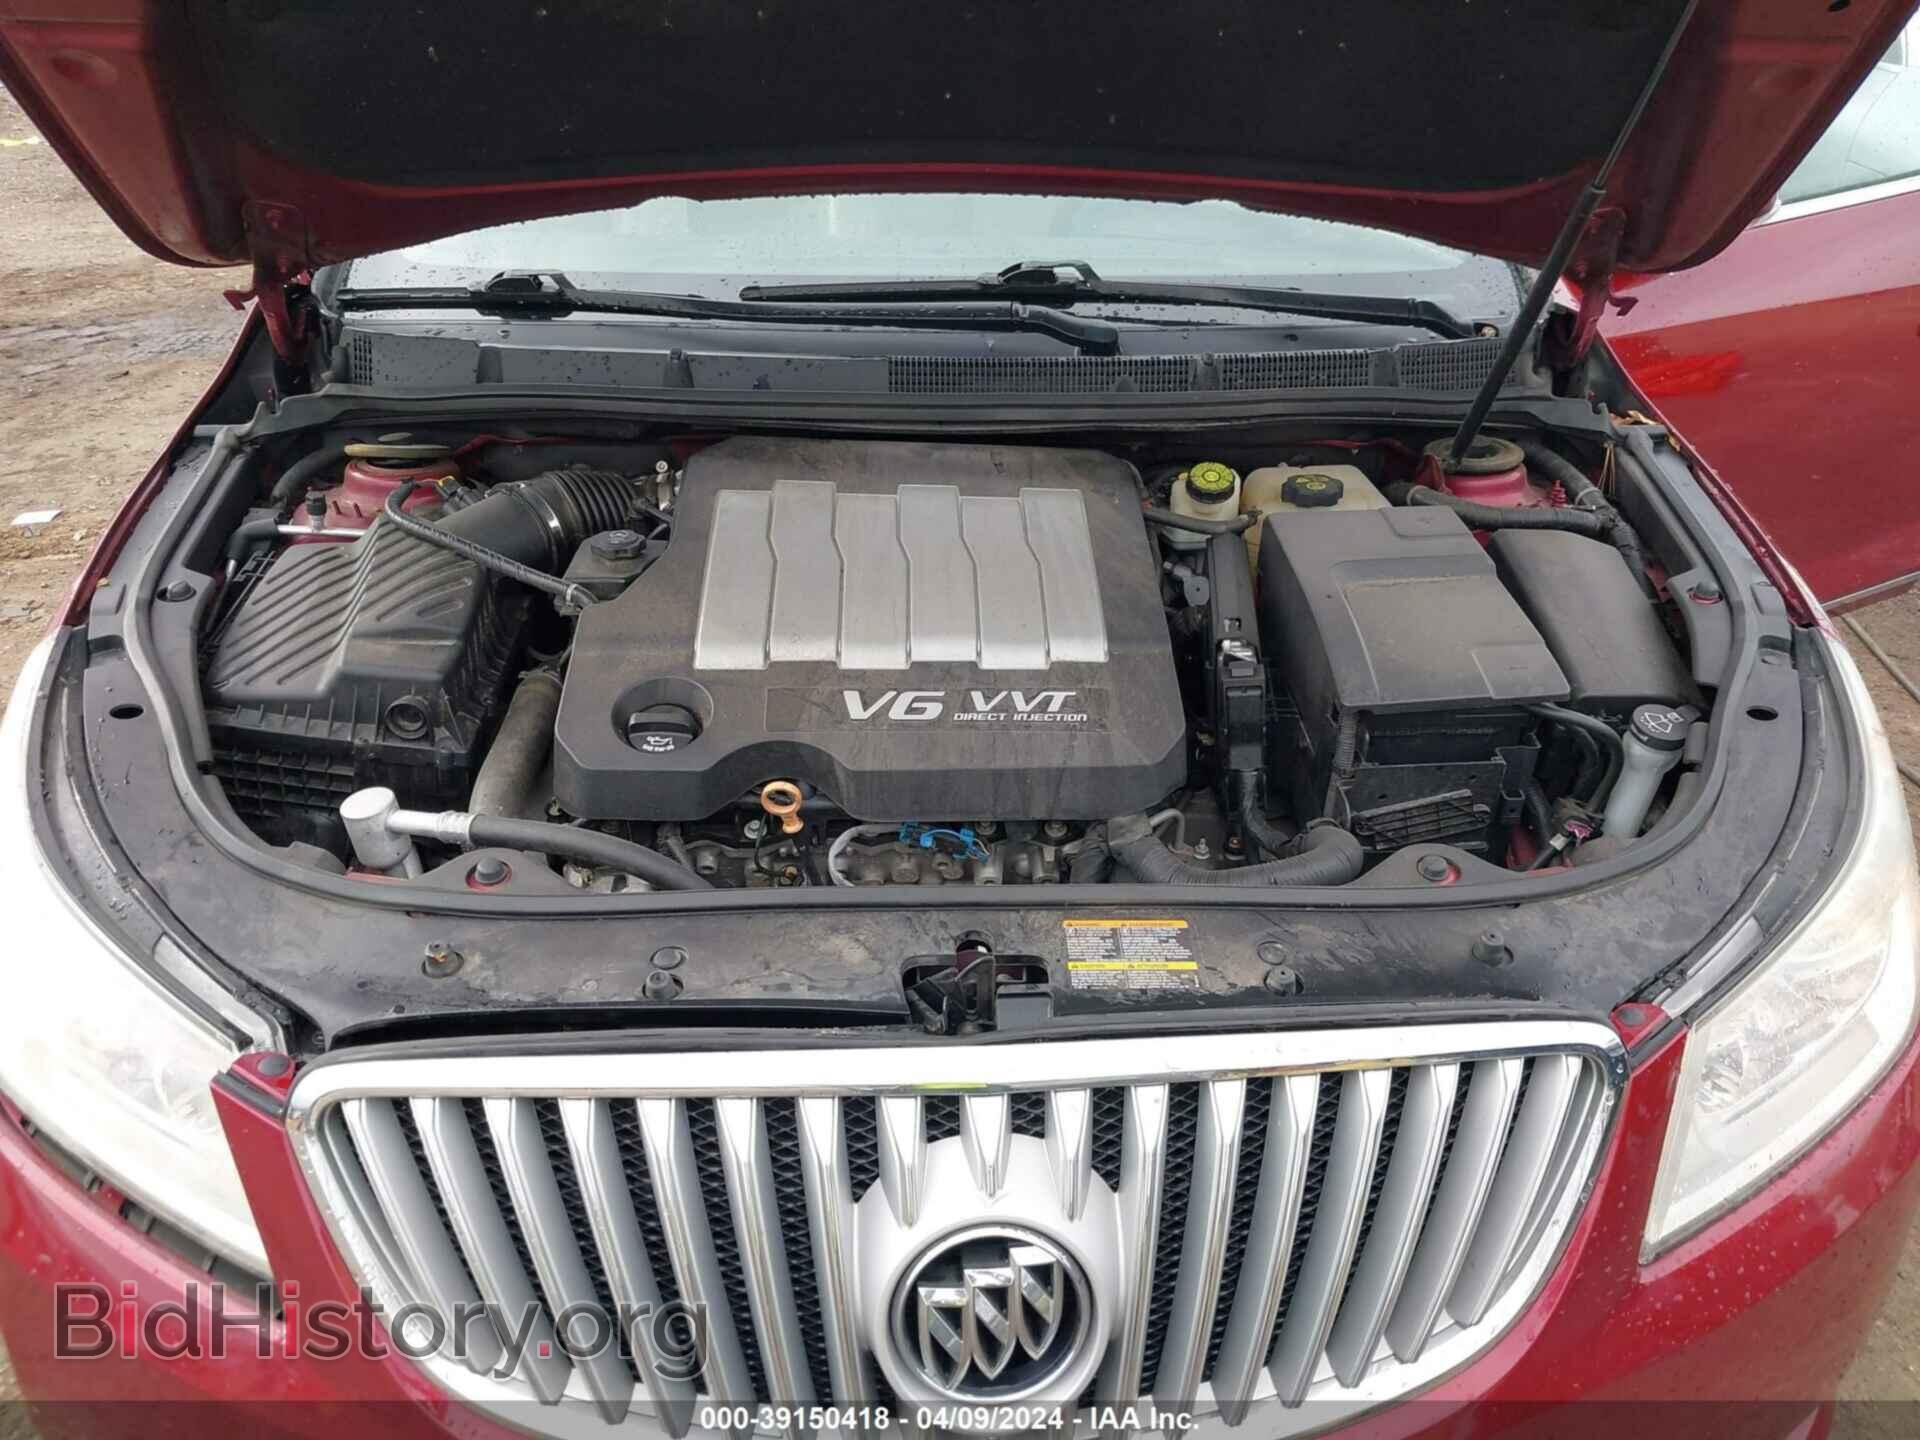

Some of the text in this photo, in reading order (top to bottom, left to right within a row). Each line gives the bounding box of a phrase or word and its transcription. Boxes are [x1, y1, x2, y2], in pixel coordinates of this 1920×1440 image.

[843, 690, 1077, 720] V6 VVT
[953, 712, 1088, 722] DIRECT INJECTION
